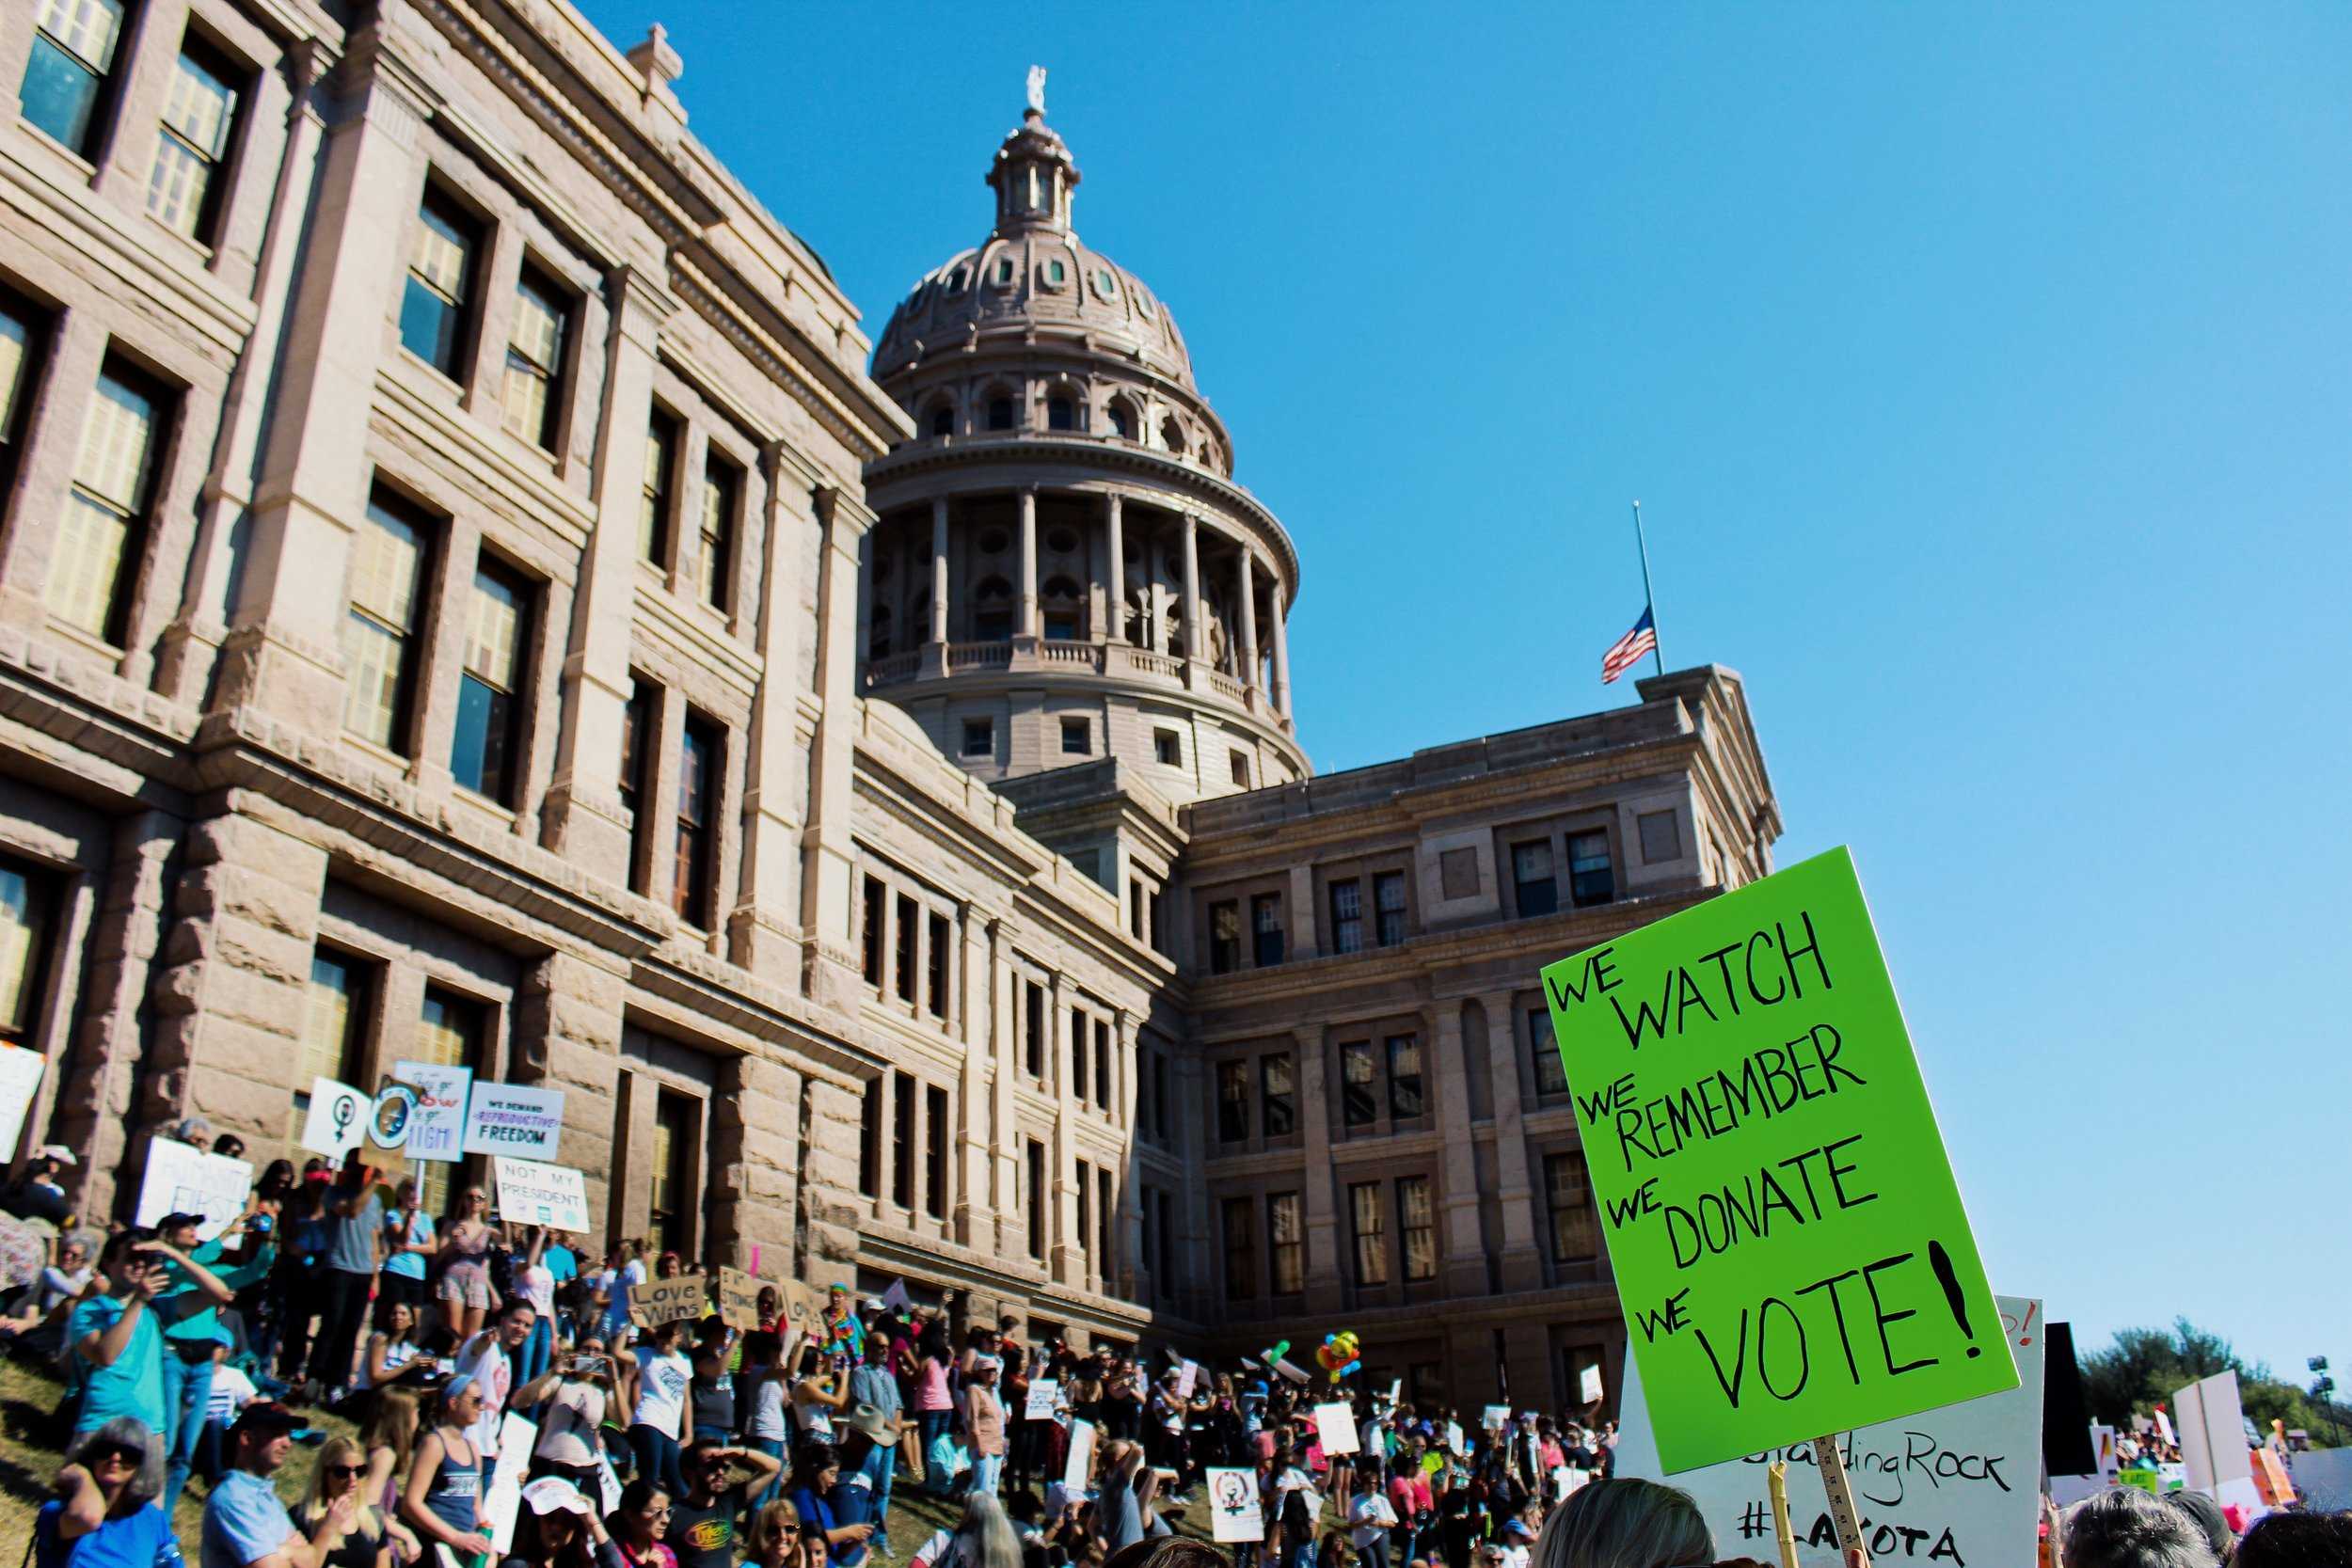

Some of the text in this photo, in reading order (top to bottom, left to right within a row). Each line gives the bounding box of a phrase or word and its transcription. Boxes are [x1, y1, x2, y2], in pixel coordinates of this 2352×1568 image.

[1549, 911, 1833, 1050] WE WATCH
[478, 1124, 546, 1146] FREEDOM
[1578, 1024, 1867, 1173] WE REMEMBER
[501, 1181, 579, 1206] PRESIDENT
[504, 1164, 573, 1187] NOT MY
[1607, 1134, 1879, 1269] WE DONATE
[1636, 1241, 1981, 1408] WE VOTE!
